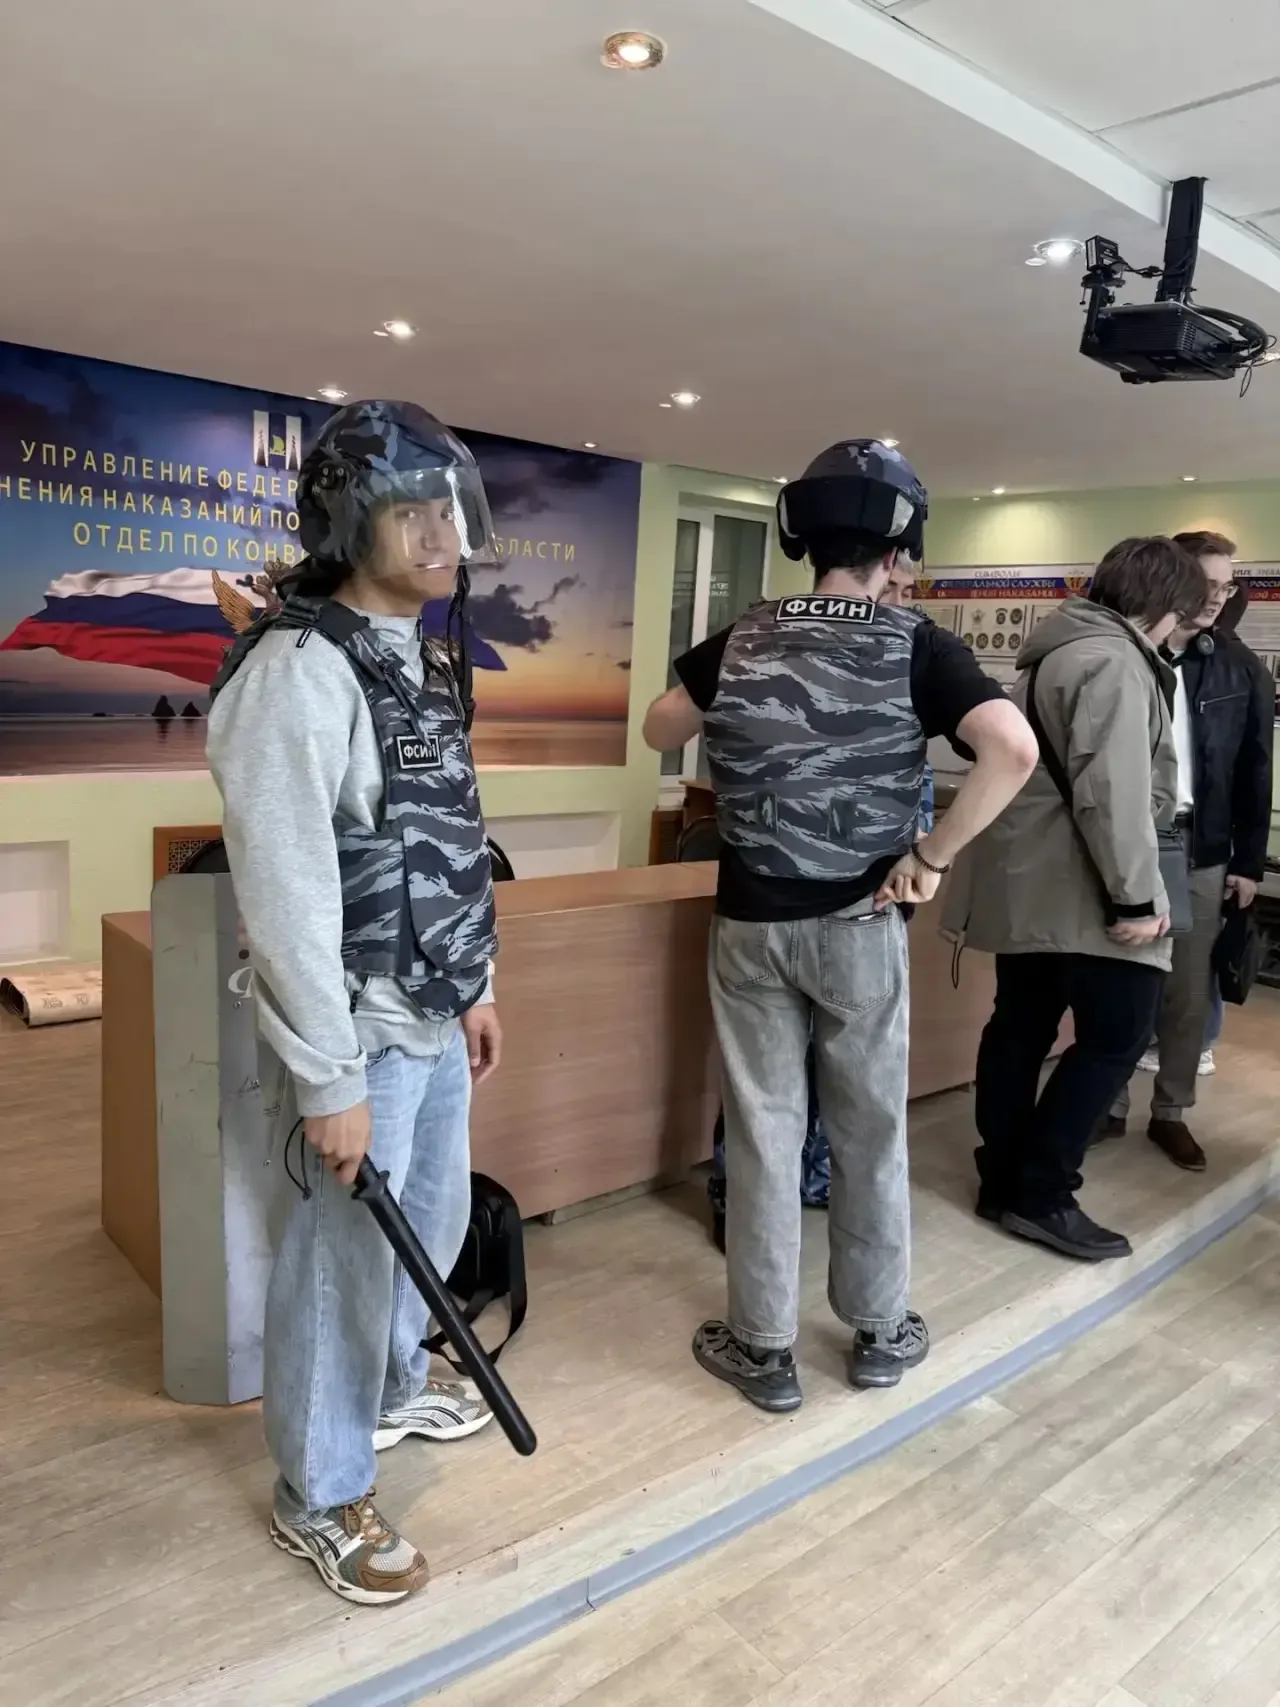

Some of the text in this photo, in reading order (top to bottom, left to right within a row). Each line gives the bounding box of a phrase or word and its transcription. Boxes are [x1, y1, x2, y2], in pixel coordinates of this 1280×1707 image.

[20, 439, 299, 498] УПРАВЛЕНИЕ ФЕДЕР
[73, 522, 174, 555] ОТДЕЛ
[183, 533, 219, 558] ПО
[103, 488, 262, 528] НАКАЗАНИЙ
[269, 508, 301, 531] ПО
[496, 537, 575, 561] БЛАСТИ
[785, 599, 868, 618] ФСИН
